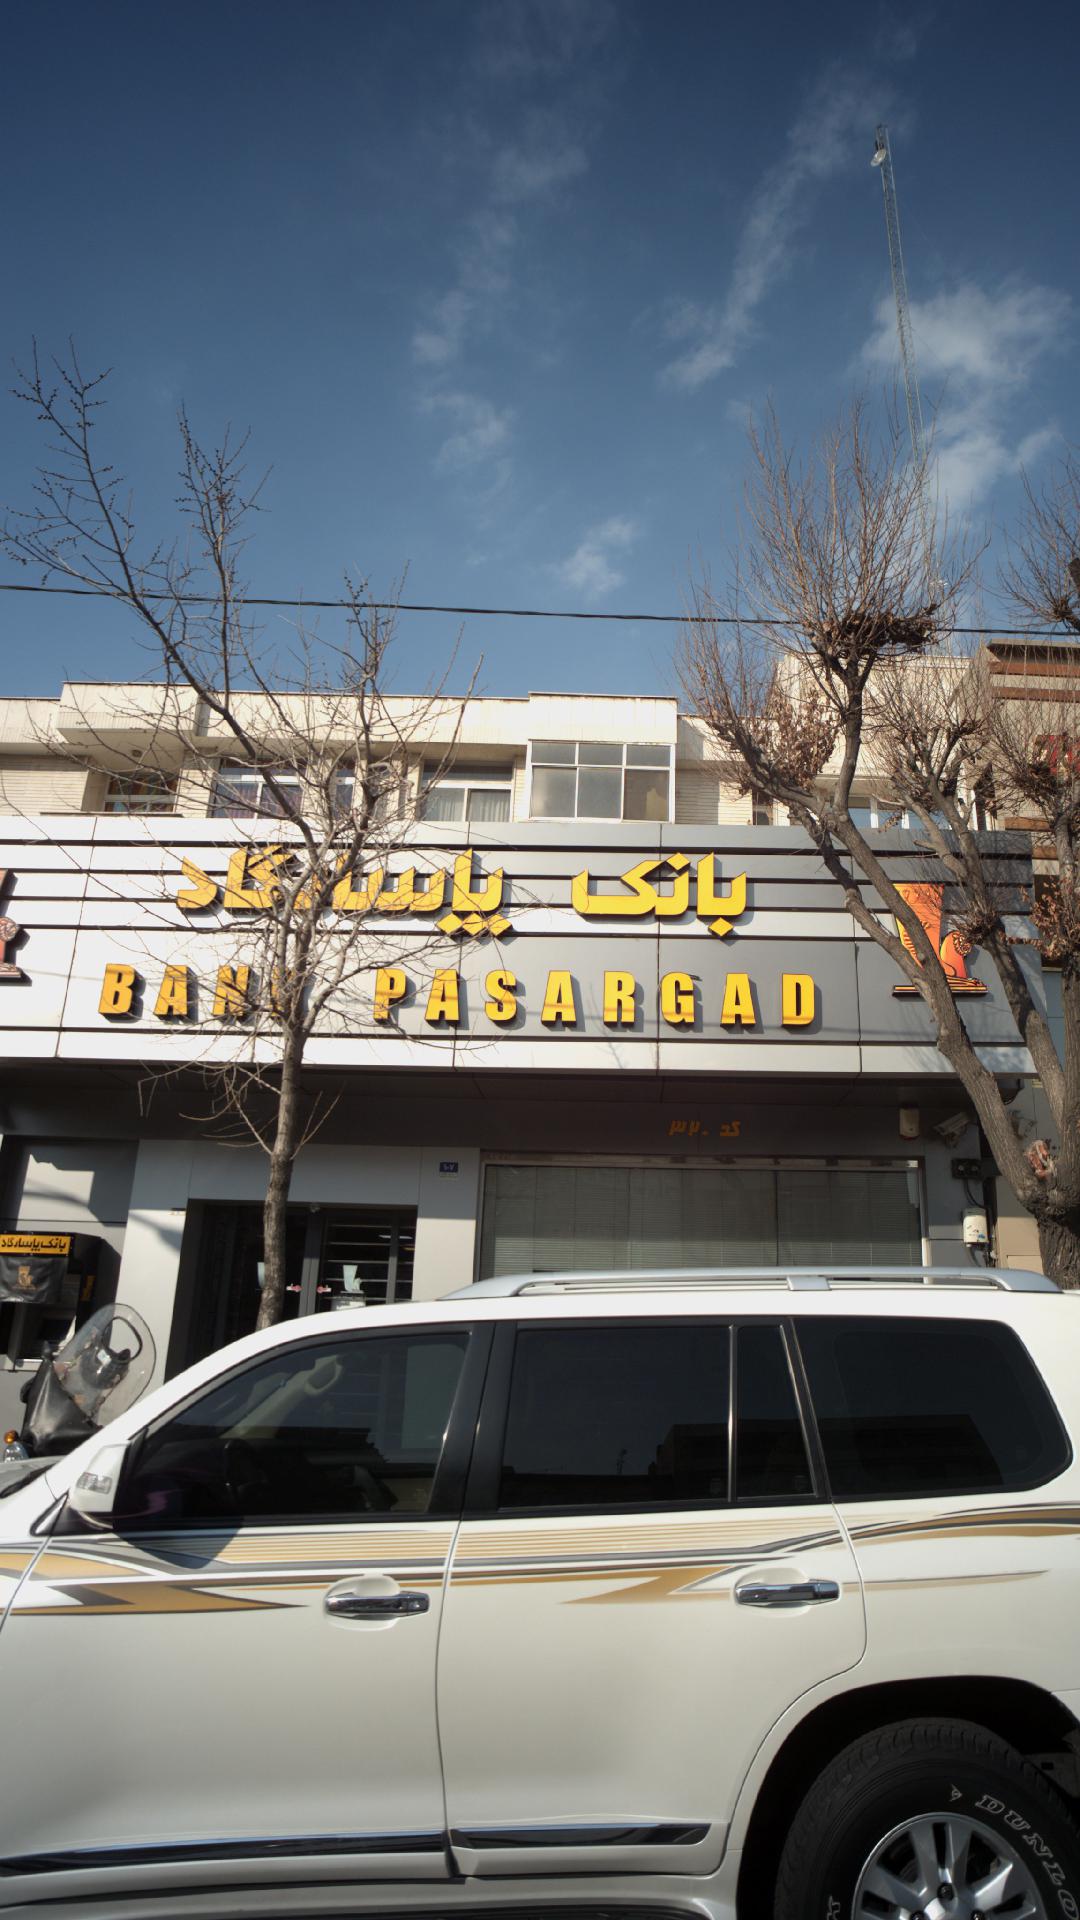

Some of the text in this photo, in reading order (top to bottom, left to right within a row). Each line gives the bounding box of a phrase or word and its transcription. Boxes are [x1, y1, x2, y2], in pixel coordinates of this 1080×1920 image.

[571, 852, 747, 936] بانک
[373, 968, 815, 1025] PASARGAD
[720, 1119, 741, 1136] کد
[1, 1237, 67, 1252] بانک پاسارگاد
